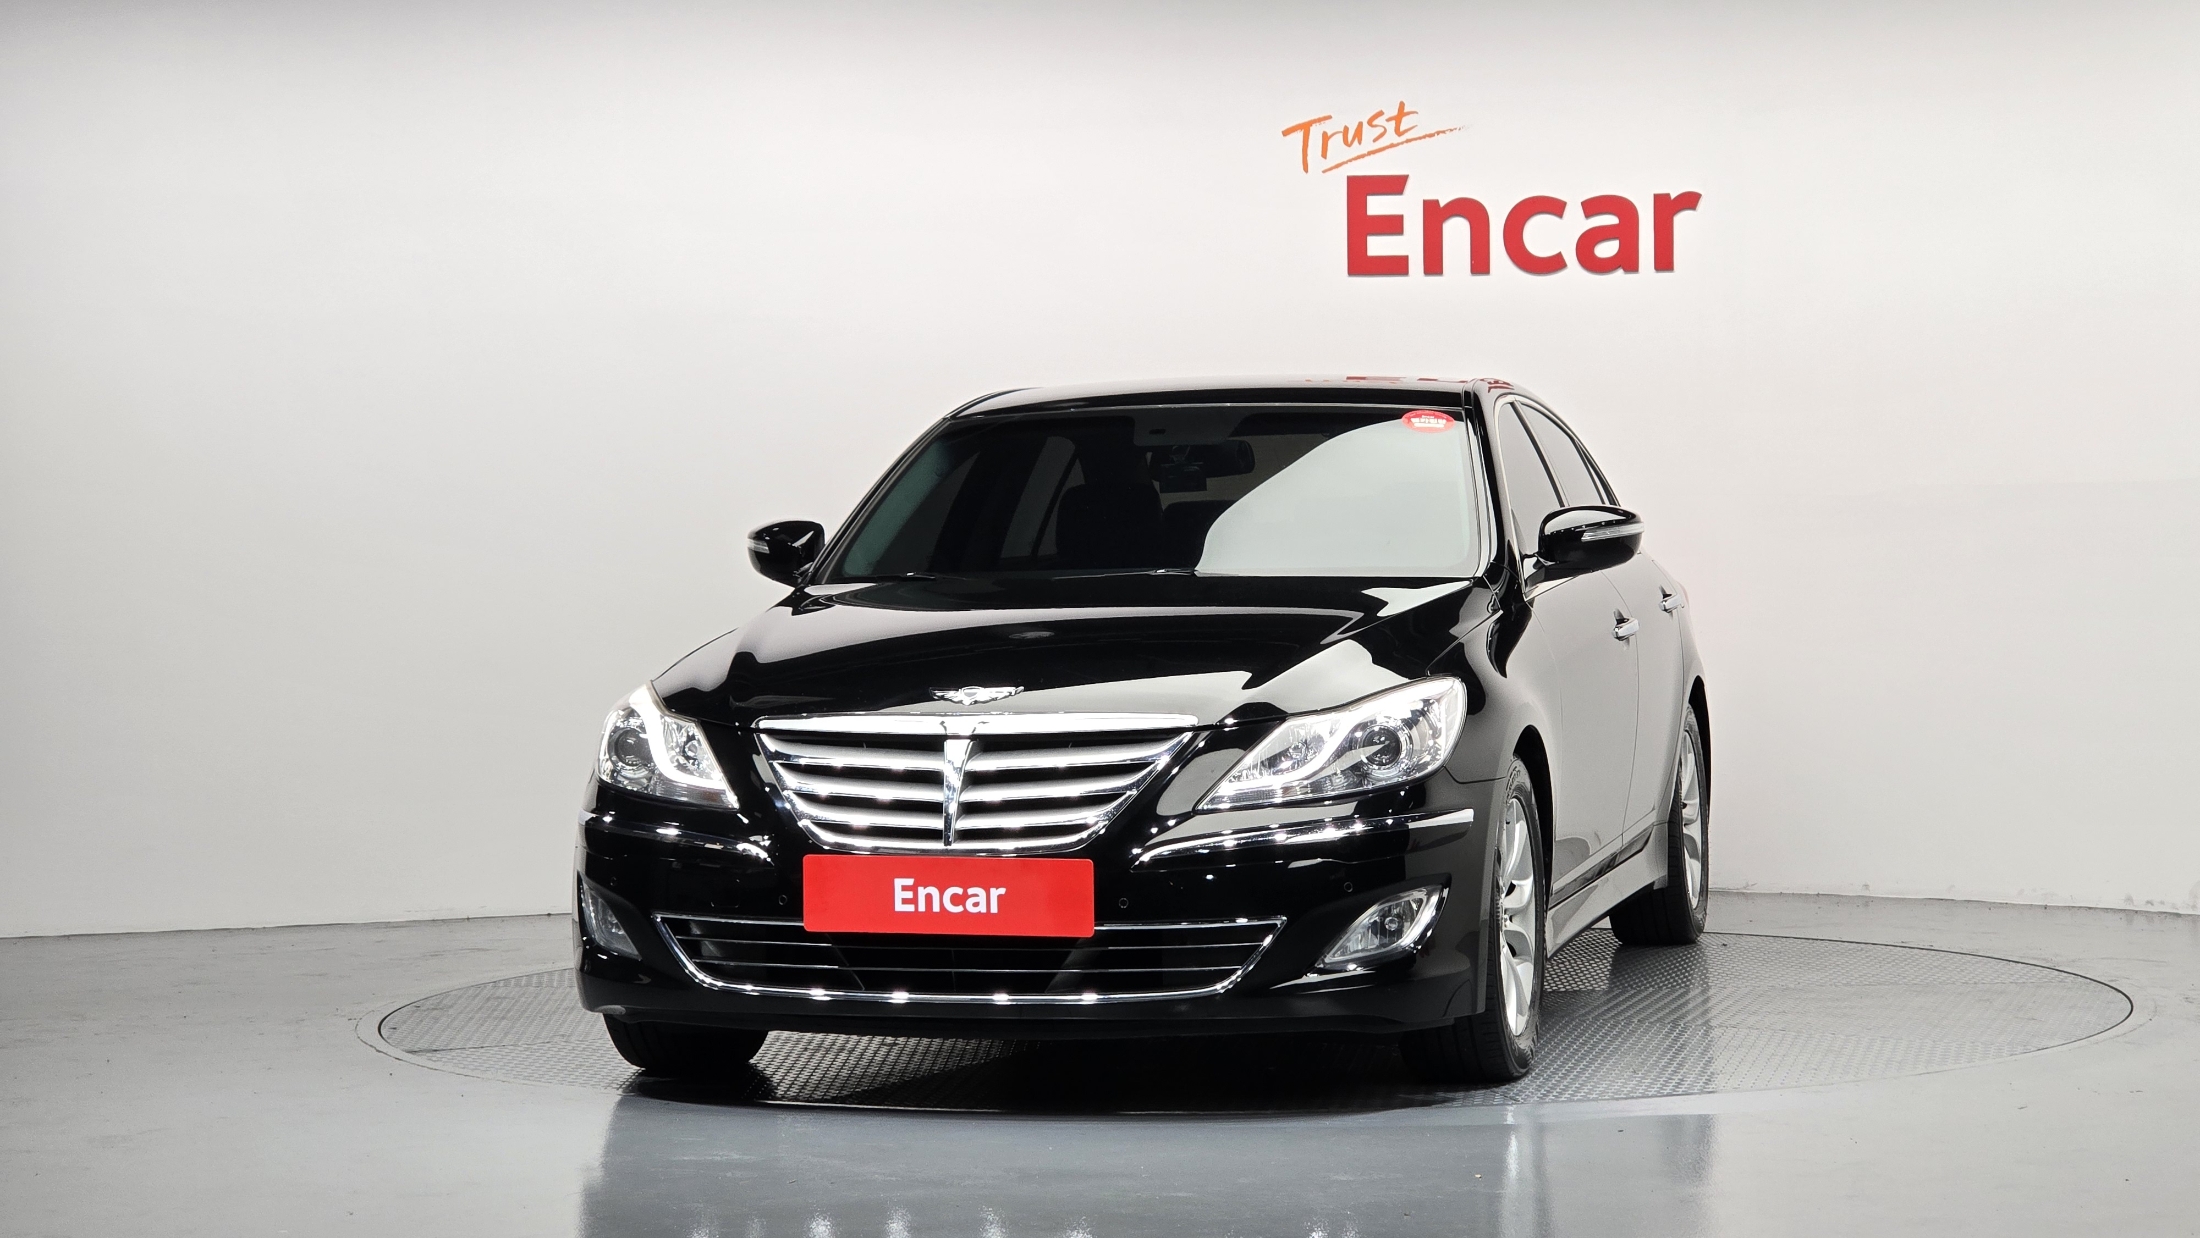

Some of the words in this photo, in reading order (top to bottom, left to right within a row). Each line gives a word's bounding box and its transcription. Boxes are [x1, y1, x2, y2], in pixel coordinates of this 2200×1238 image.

[1282, 101, 1418, 173] Trust
[1347, 174, 1702, 276] Encar
[894, 878, 1006, 913] Encar
